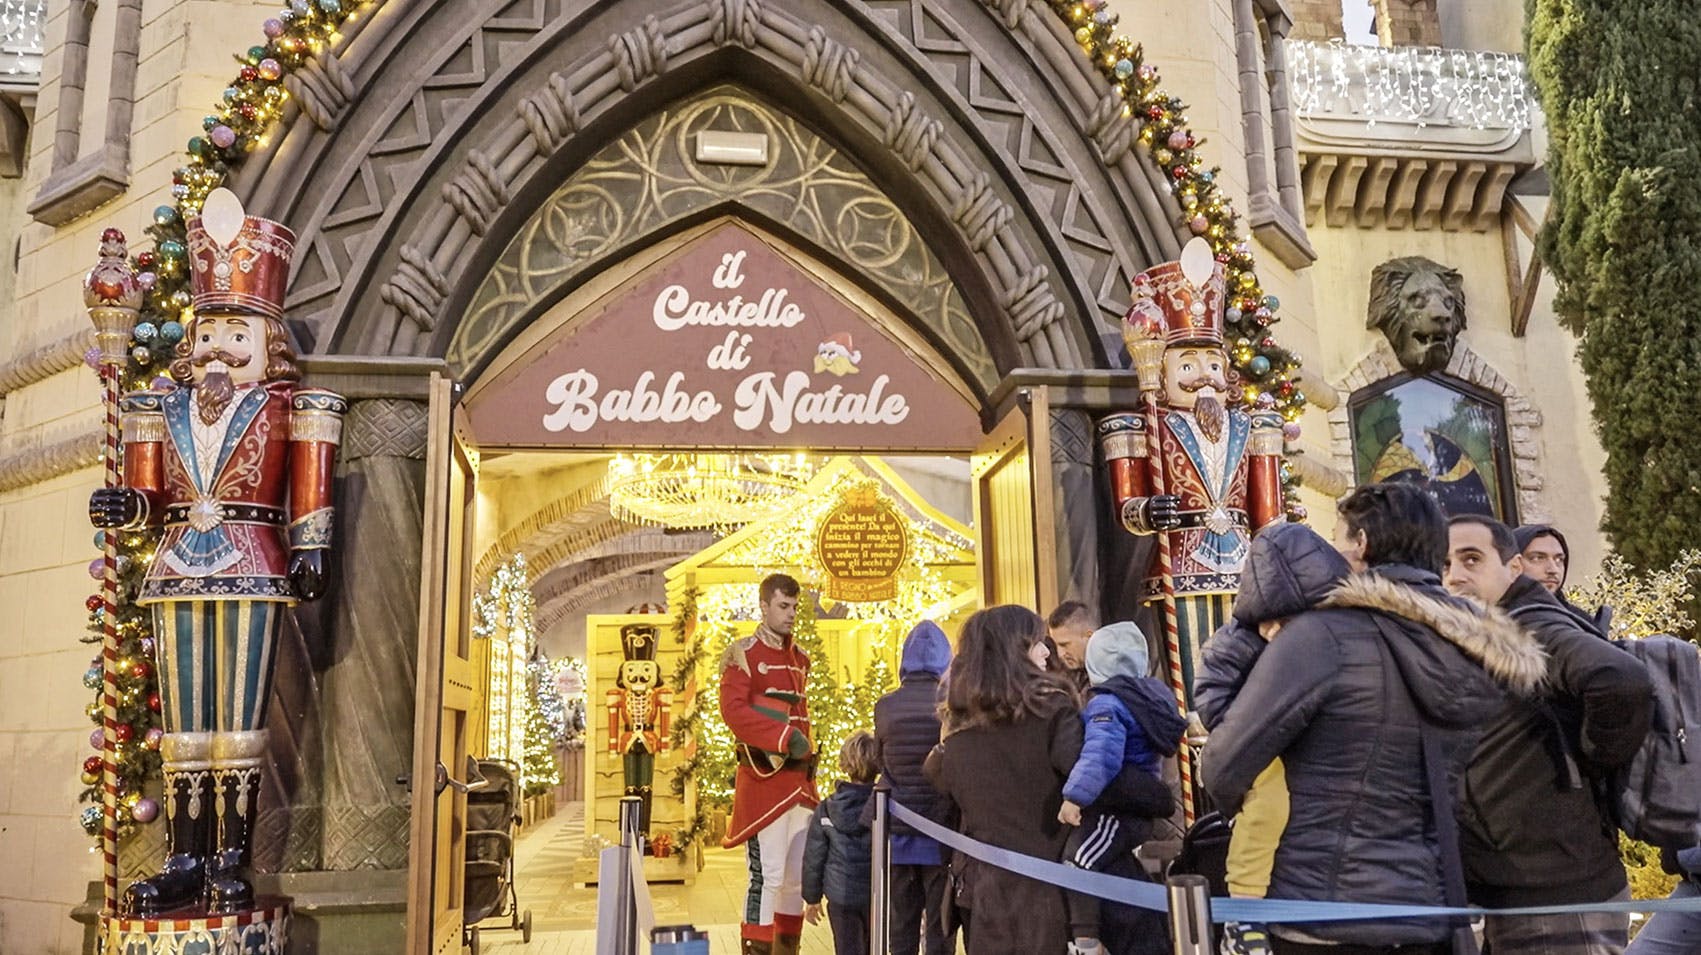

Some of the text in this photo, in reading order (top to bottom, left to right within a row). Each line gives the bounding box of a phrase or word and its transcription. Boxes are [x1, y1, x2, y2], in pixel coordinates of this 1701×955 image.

[713, 250, 746, 289] il
[653, 285, 805, 331] Castello
[706, 331, 753, 371] di
[543, 368, 910, 434] Babbo Natale
[840, 513, 886, 523] Qui lasci il
[829, 522, 896, 533] presente! Da qui
[826, 532, 900, 544] inizia il magico
[824, 541, 859, 549] cammino
[861, 543, 872, 551] per
[835, 550, 859, 559] vedere
[862, 551, 868, 559] il
[871, 550, 898, 559] mondo
[848, 559, 860, 570] gli
[862, 559, 883, 567] occhi
[885, 559, 893, 567] di
[851, 568, 887, 577] bambino
